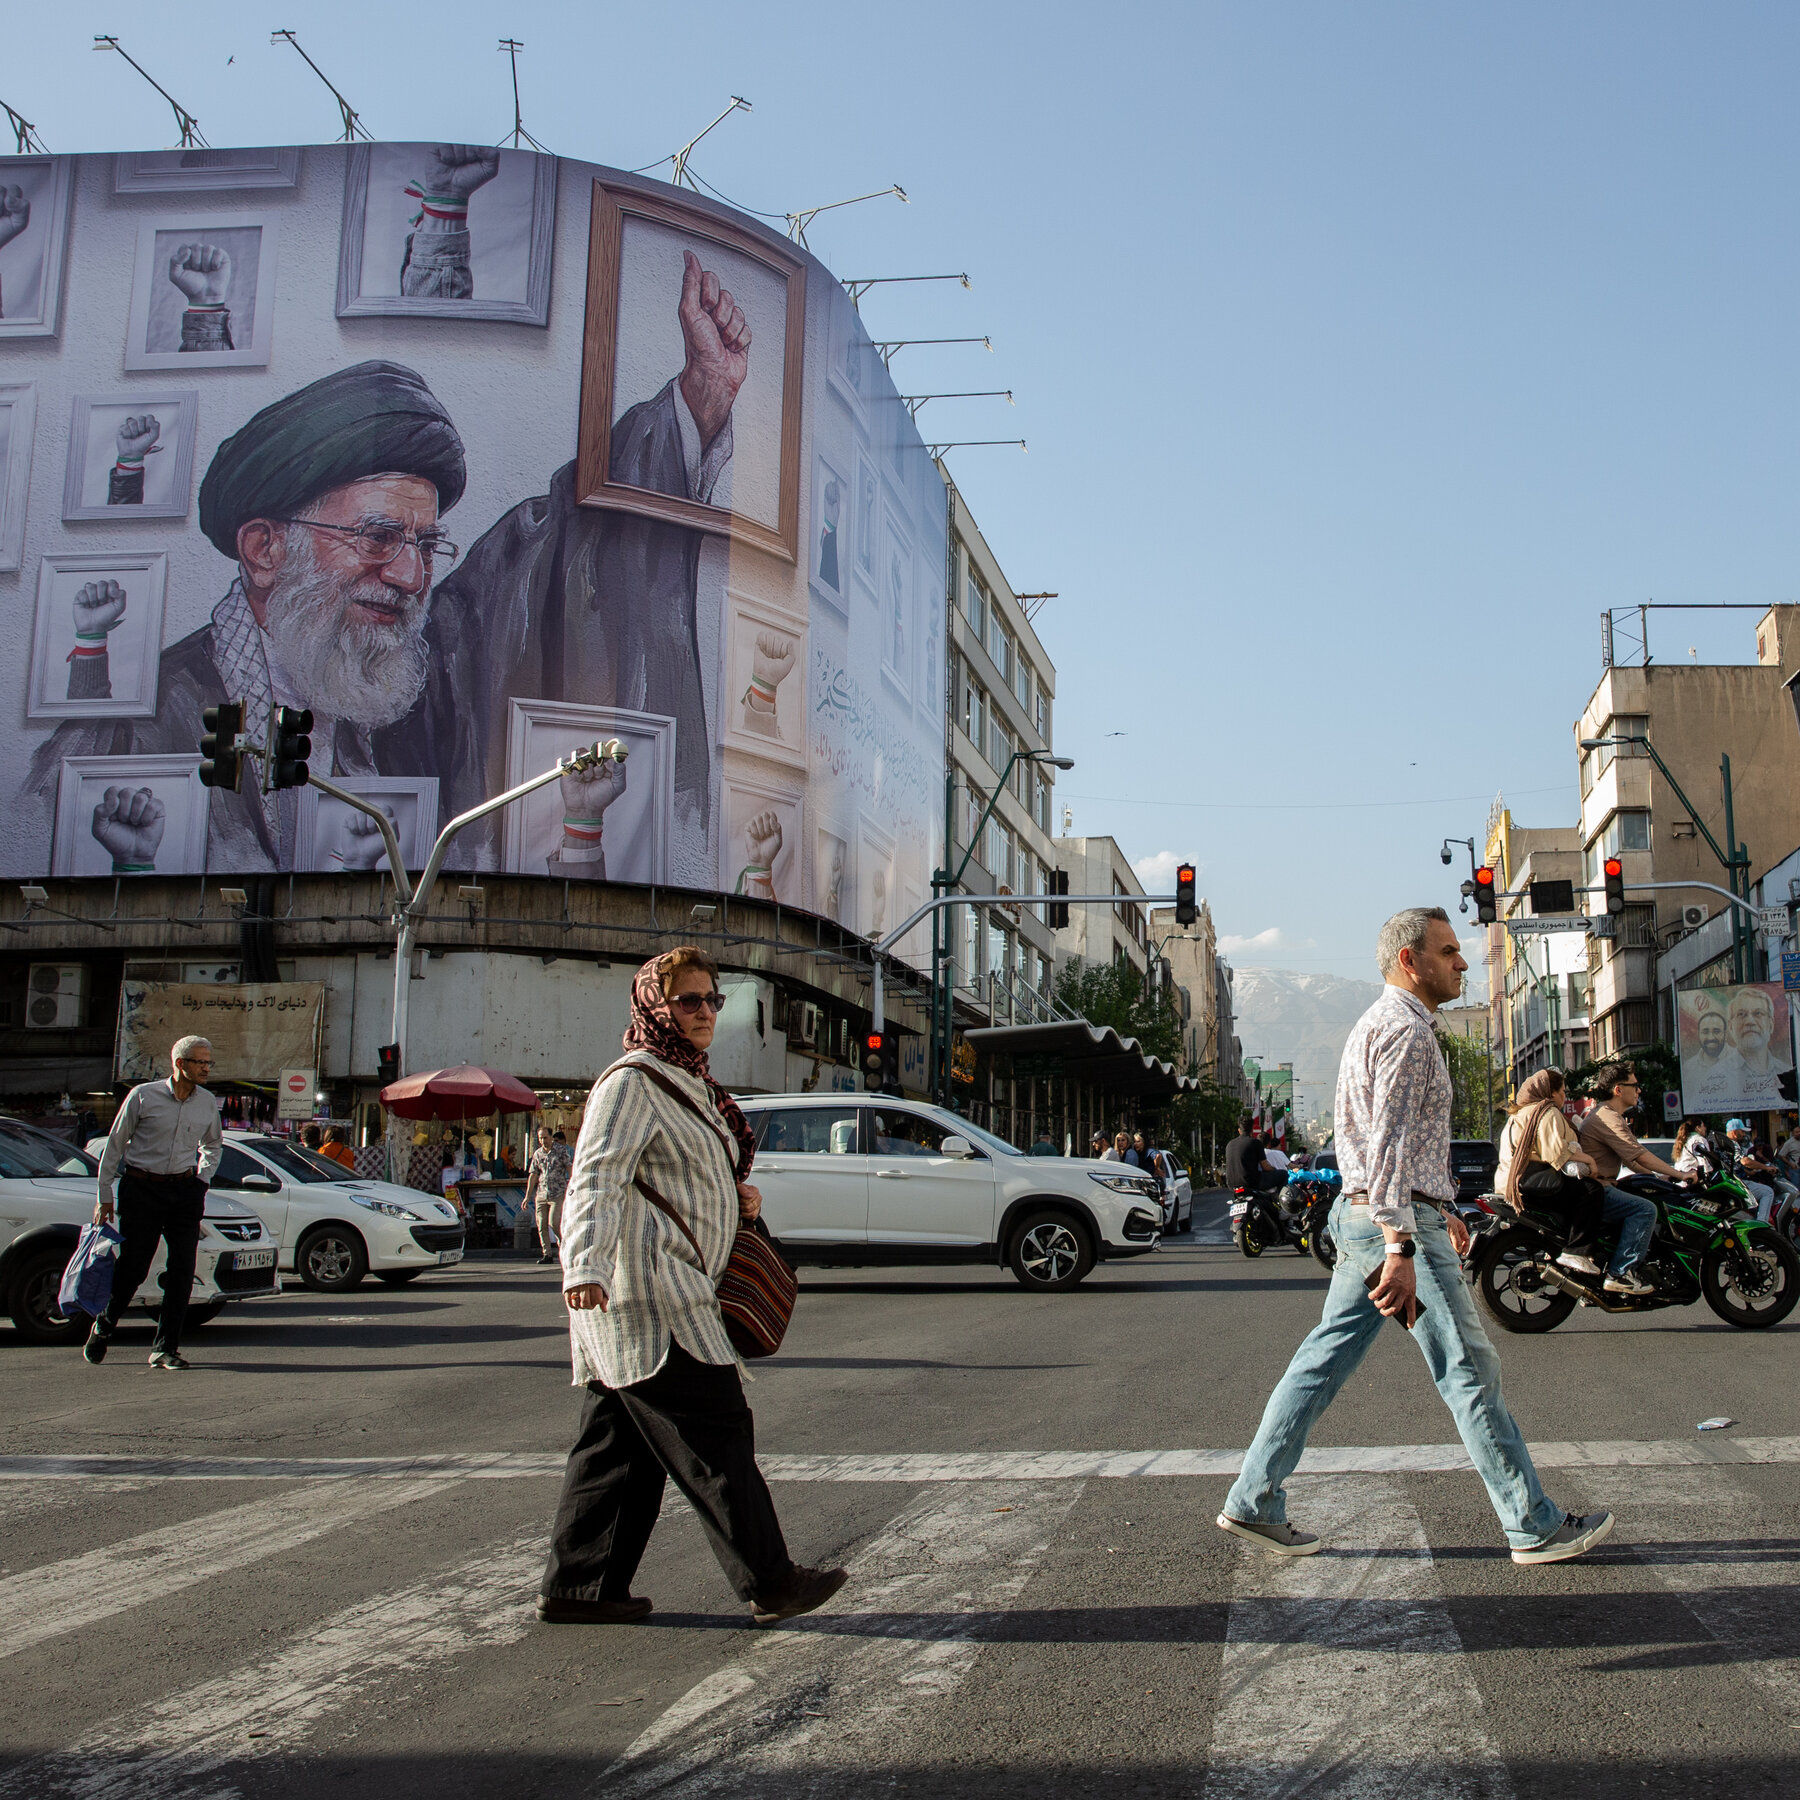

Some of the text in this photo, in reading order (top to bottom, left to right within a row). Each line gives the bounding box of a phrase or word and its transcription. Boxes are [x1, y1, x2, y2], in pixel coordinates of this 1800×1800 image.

[1512, 920, 1567, 931] جمهوری اسلامی
[182, 995, 307, 1012] دنیای لاک و بدلیجات روشا
